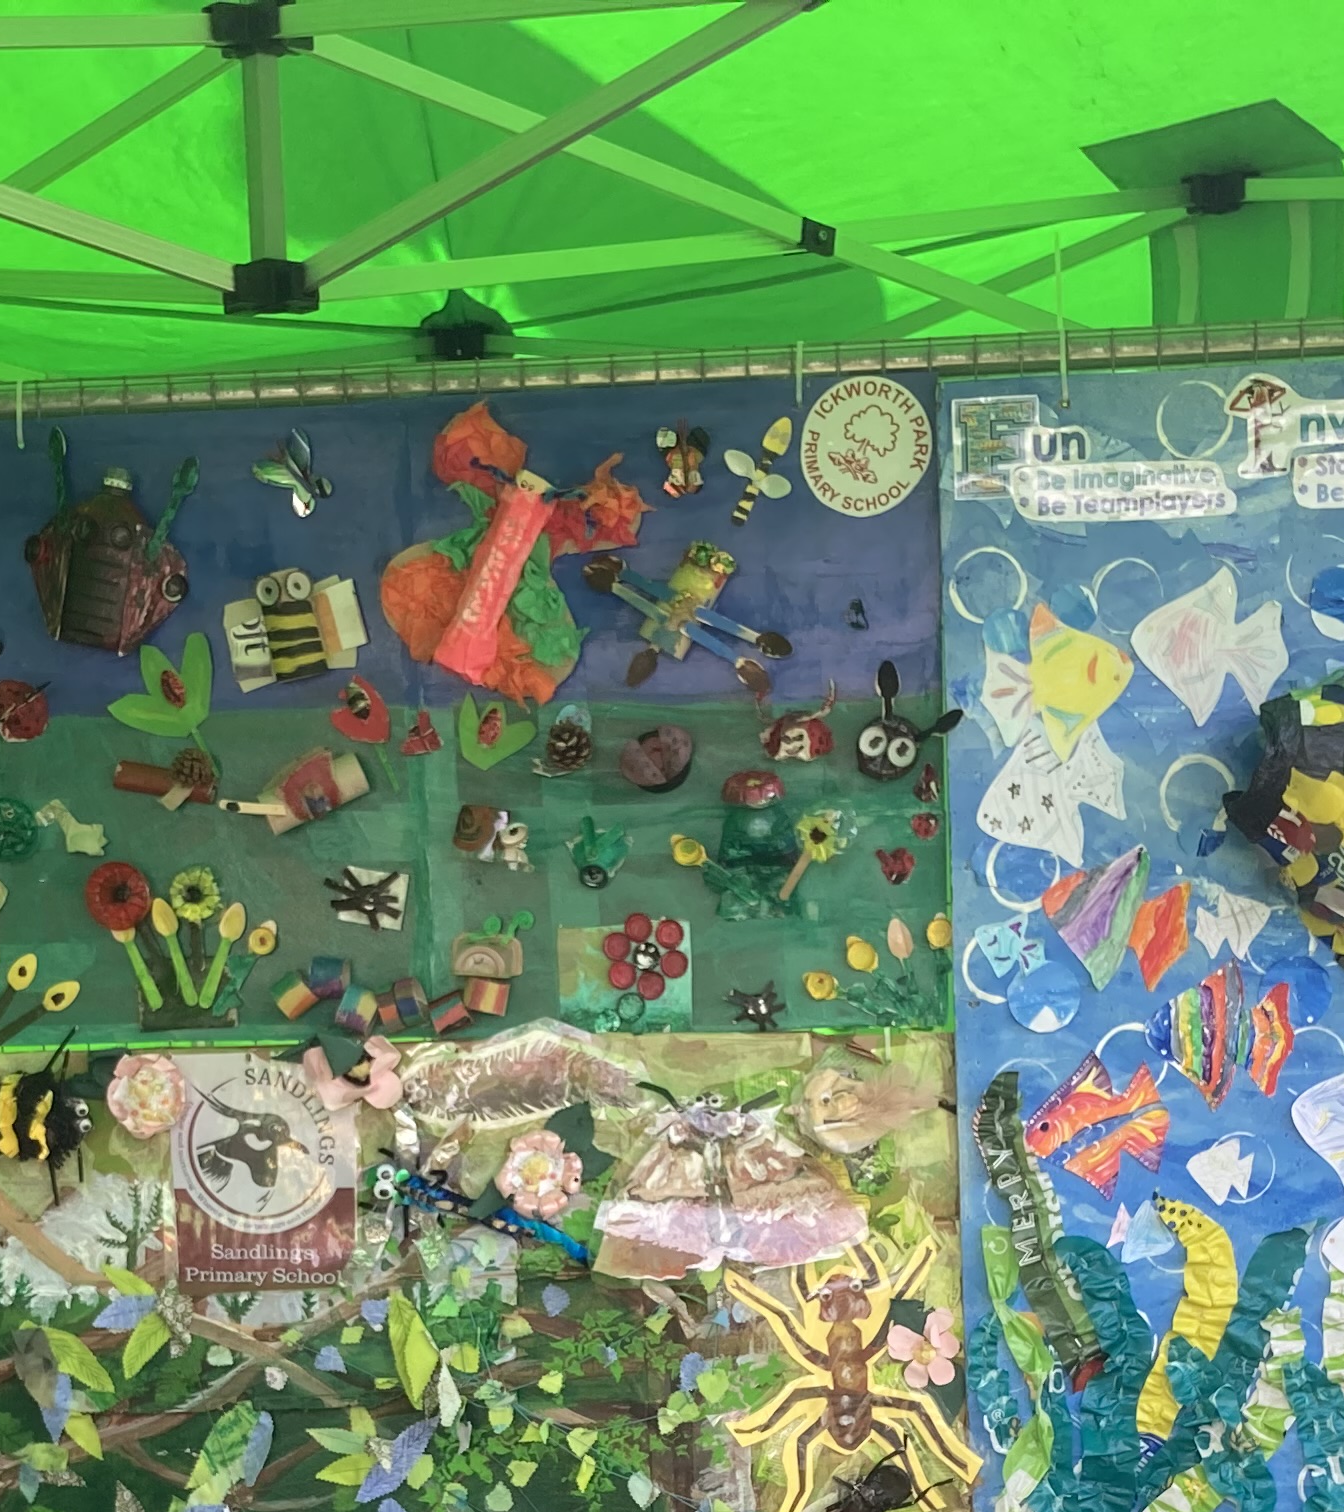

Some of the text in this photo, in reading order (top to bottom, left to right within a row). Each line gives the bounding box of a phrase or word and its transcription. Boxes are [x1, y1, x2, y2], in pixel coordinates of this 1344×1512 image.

[814, 380, 929, 471] ICKWORTH PARK
[958, 401, 1087, 495] Fun
[804, 429, 912, 512] PRIMARY SCHOOL
[1037, 464, 1217, 493] Be Imaginative
[1037, 491, 1227, 517] Be Teamplayers
[244, 1067, 336, 1167] SANDLINGS
[987, 1146, 1045, 1269] MERRY
[184, 1264, 343, 1287] Primary School
[210, 1243, 315, 1265] Sandlings
